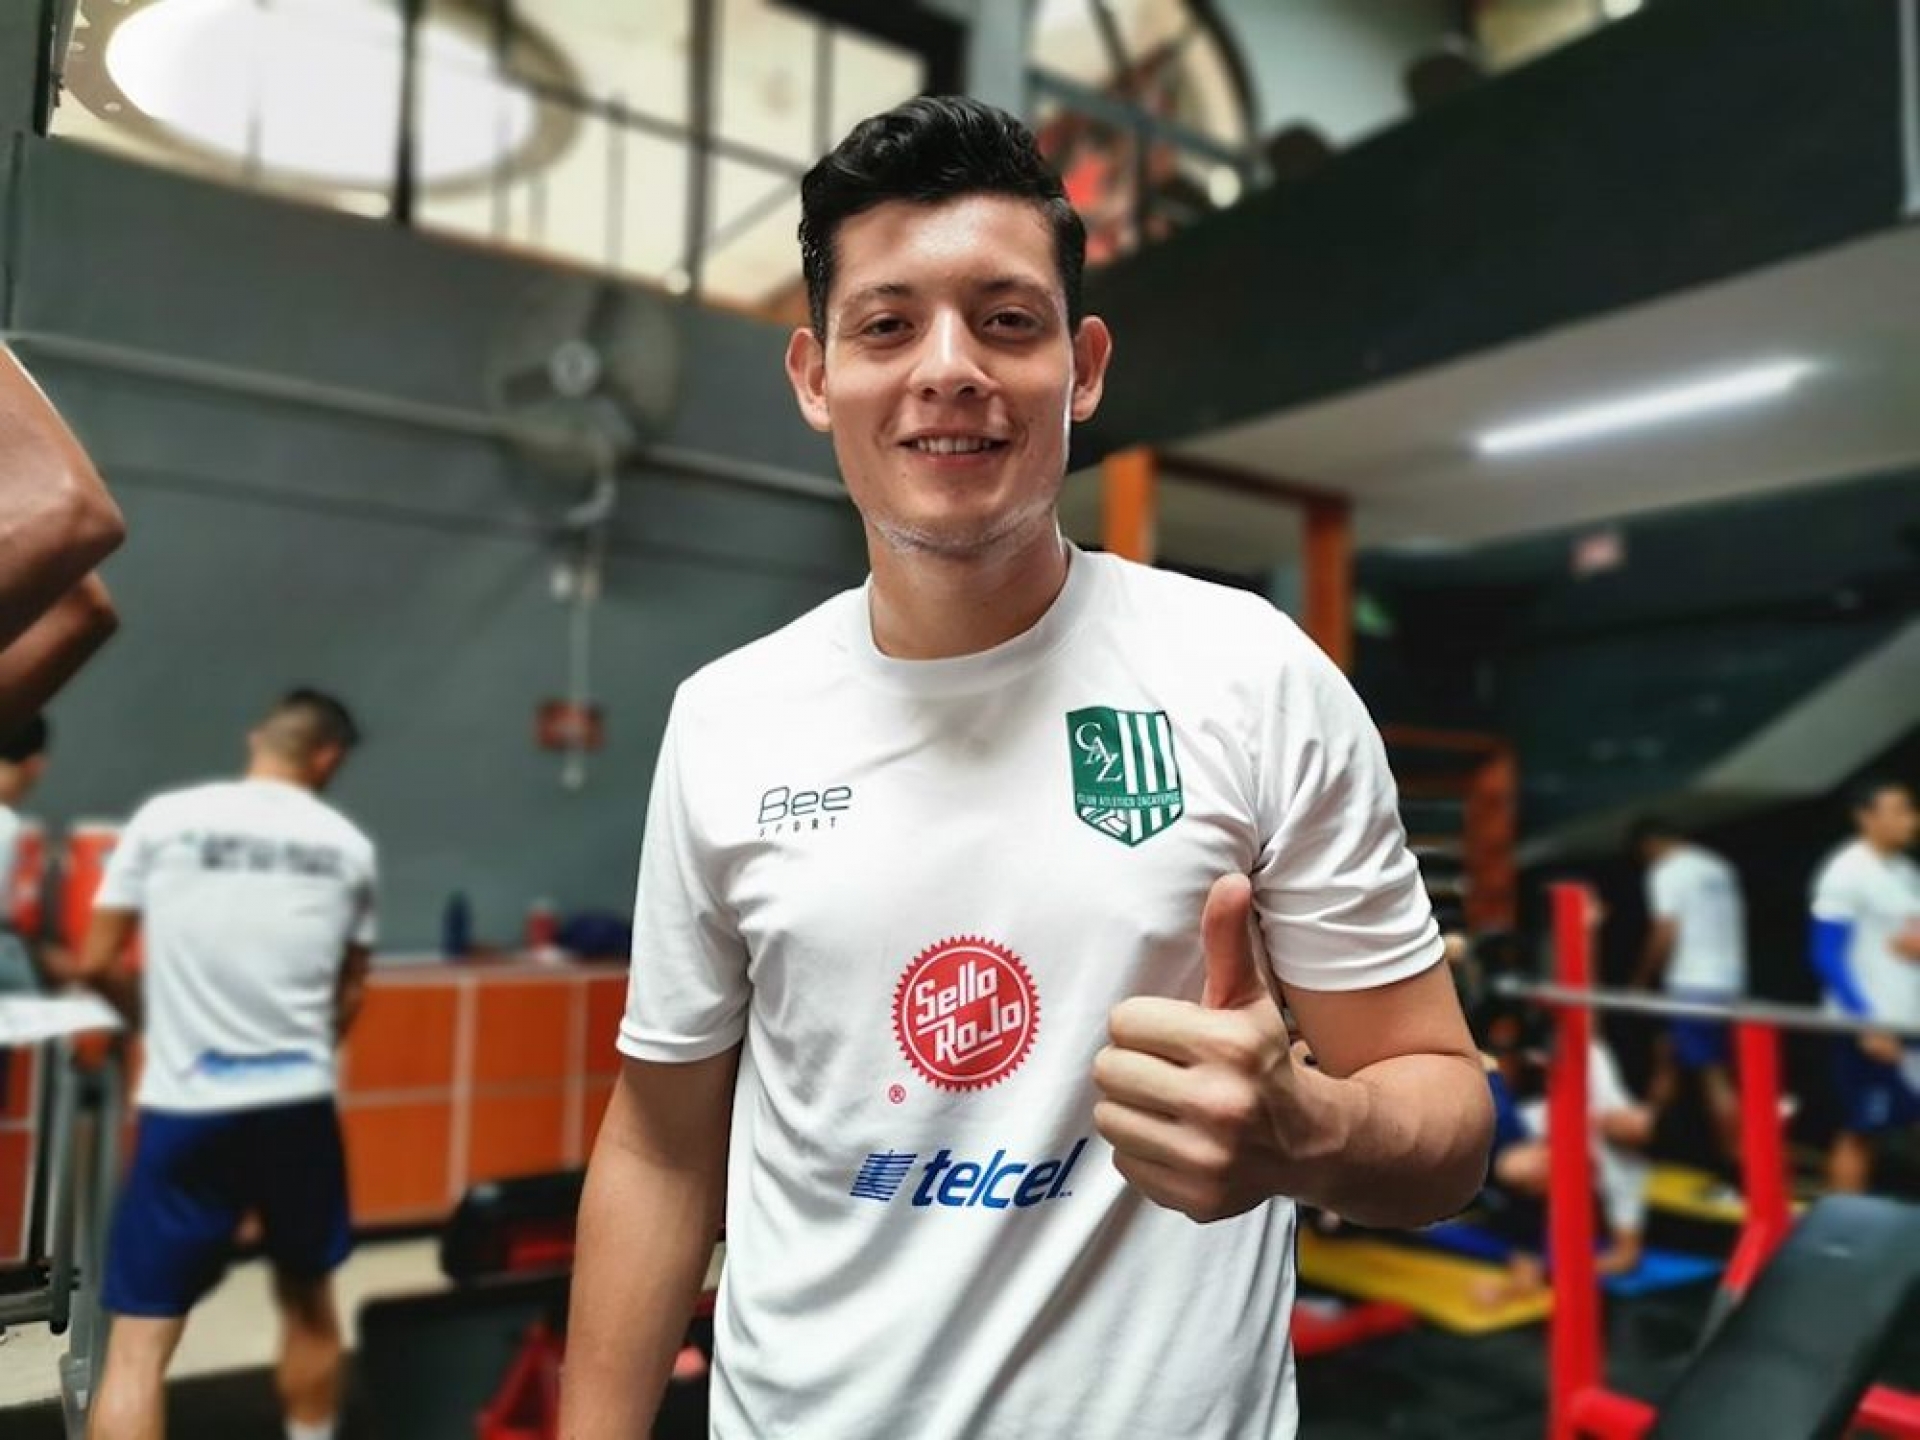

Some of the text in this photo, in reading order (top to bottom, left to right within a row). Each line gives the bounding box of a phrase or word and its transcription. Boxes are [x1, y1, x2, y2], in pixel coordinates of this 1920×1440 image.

[758, 785, 852, 824] Bee
[914, 960, 998, 1025] Sello
[911, 1137, 1089, 1208] telcel
